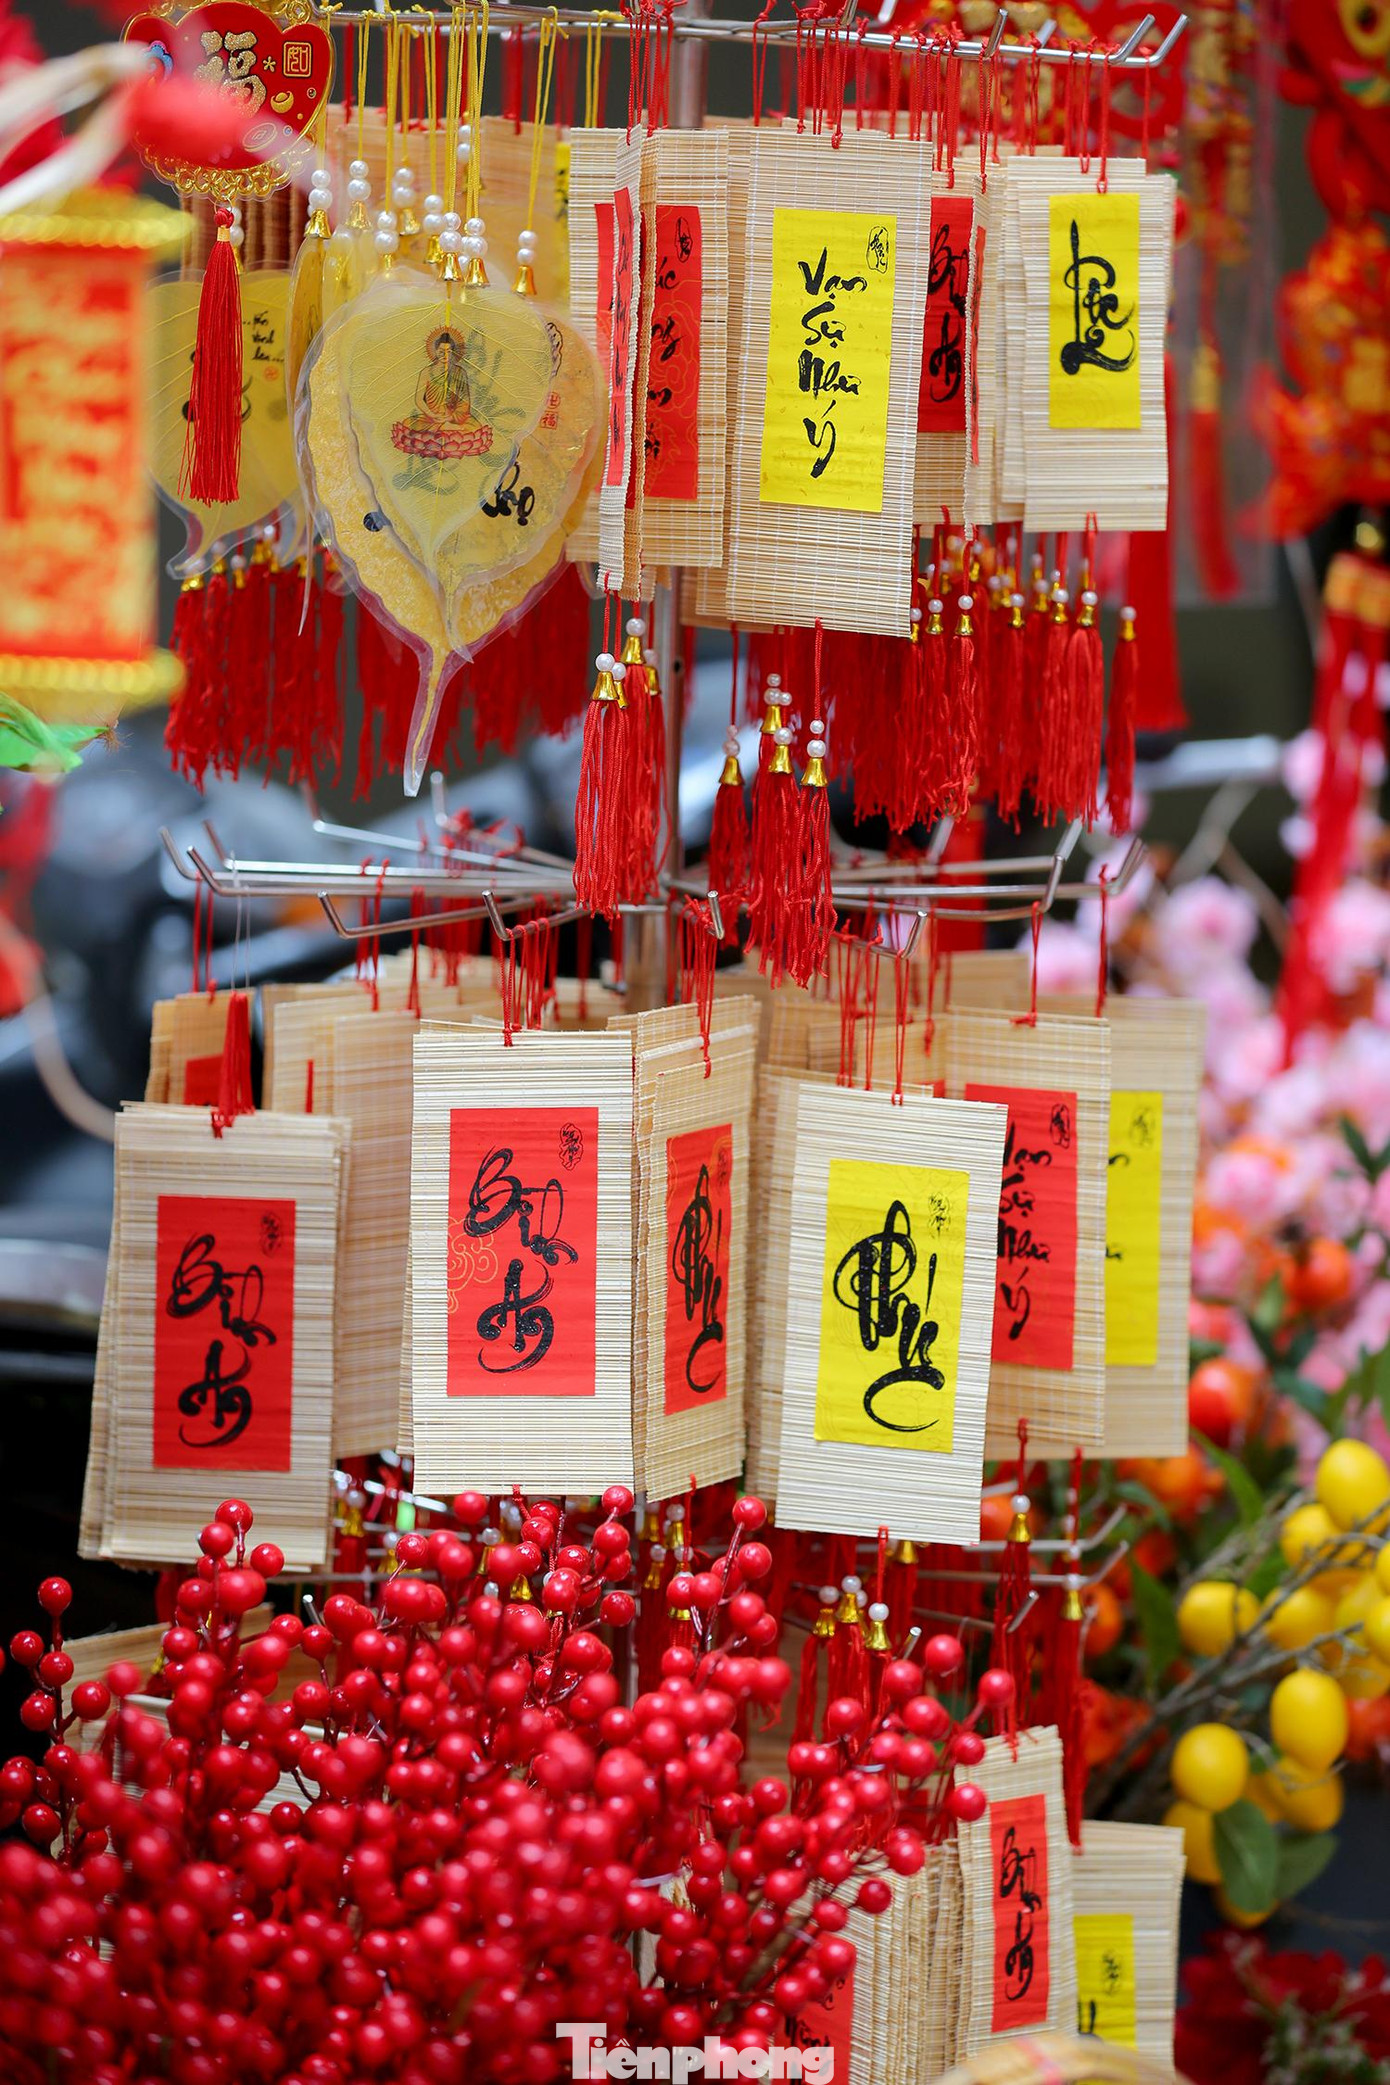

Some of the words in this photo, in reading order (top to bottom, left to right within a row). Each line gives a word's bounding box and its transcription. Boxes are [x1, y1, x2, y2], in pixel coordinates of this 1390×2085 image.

[797, 246, 868, 300] Vạn
[801, 301, 847, 349] Sự
[797, 349, 862, 400] Như
[833, 1199, 946, 1433] Phúc
